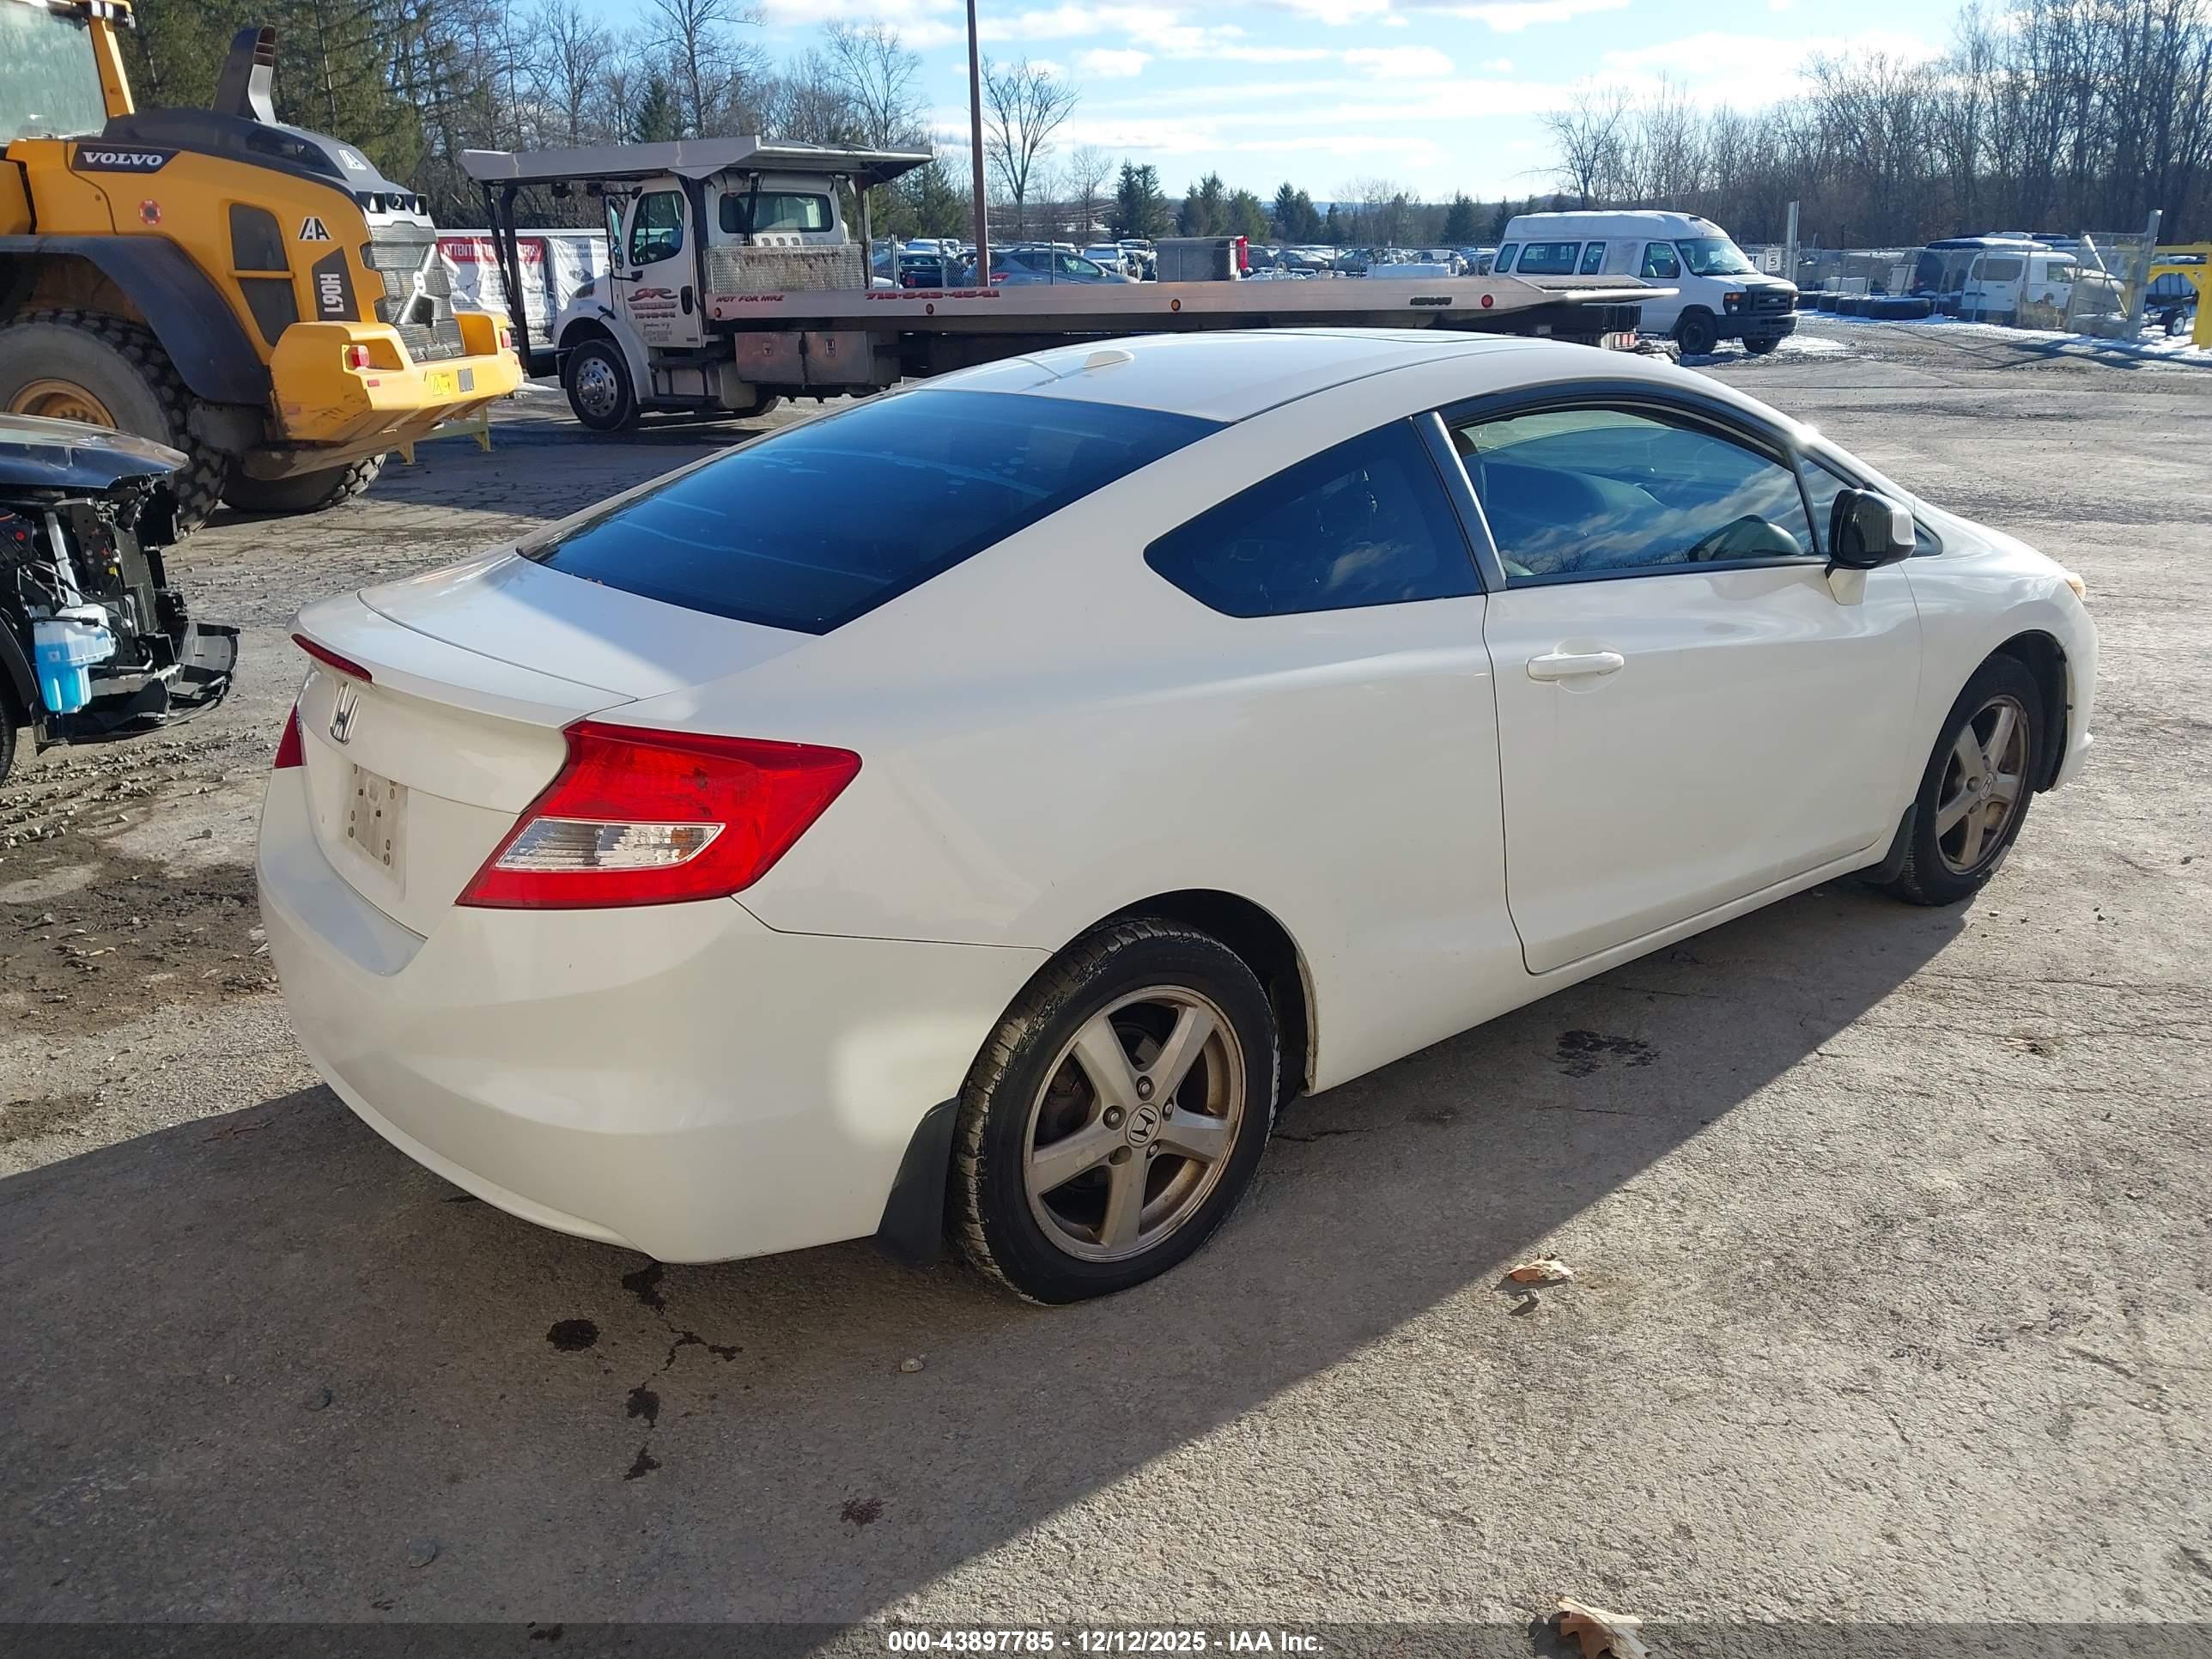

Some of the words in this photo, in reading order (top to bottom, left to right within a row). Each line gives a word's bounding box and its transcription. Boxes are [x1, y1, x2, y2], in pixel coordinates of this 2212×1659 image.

[82, 151, 163, 166] VOLVO
[1770, 257, 1778, 266] 5
[319, 273, 344, 313] L90H
